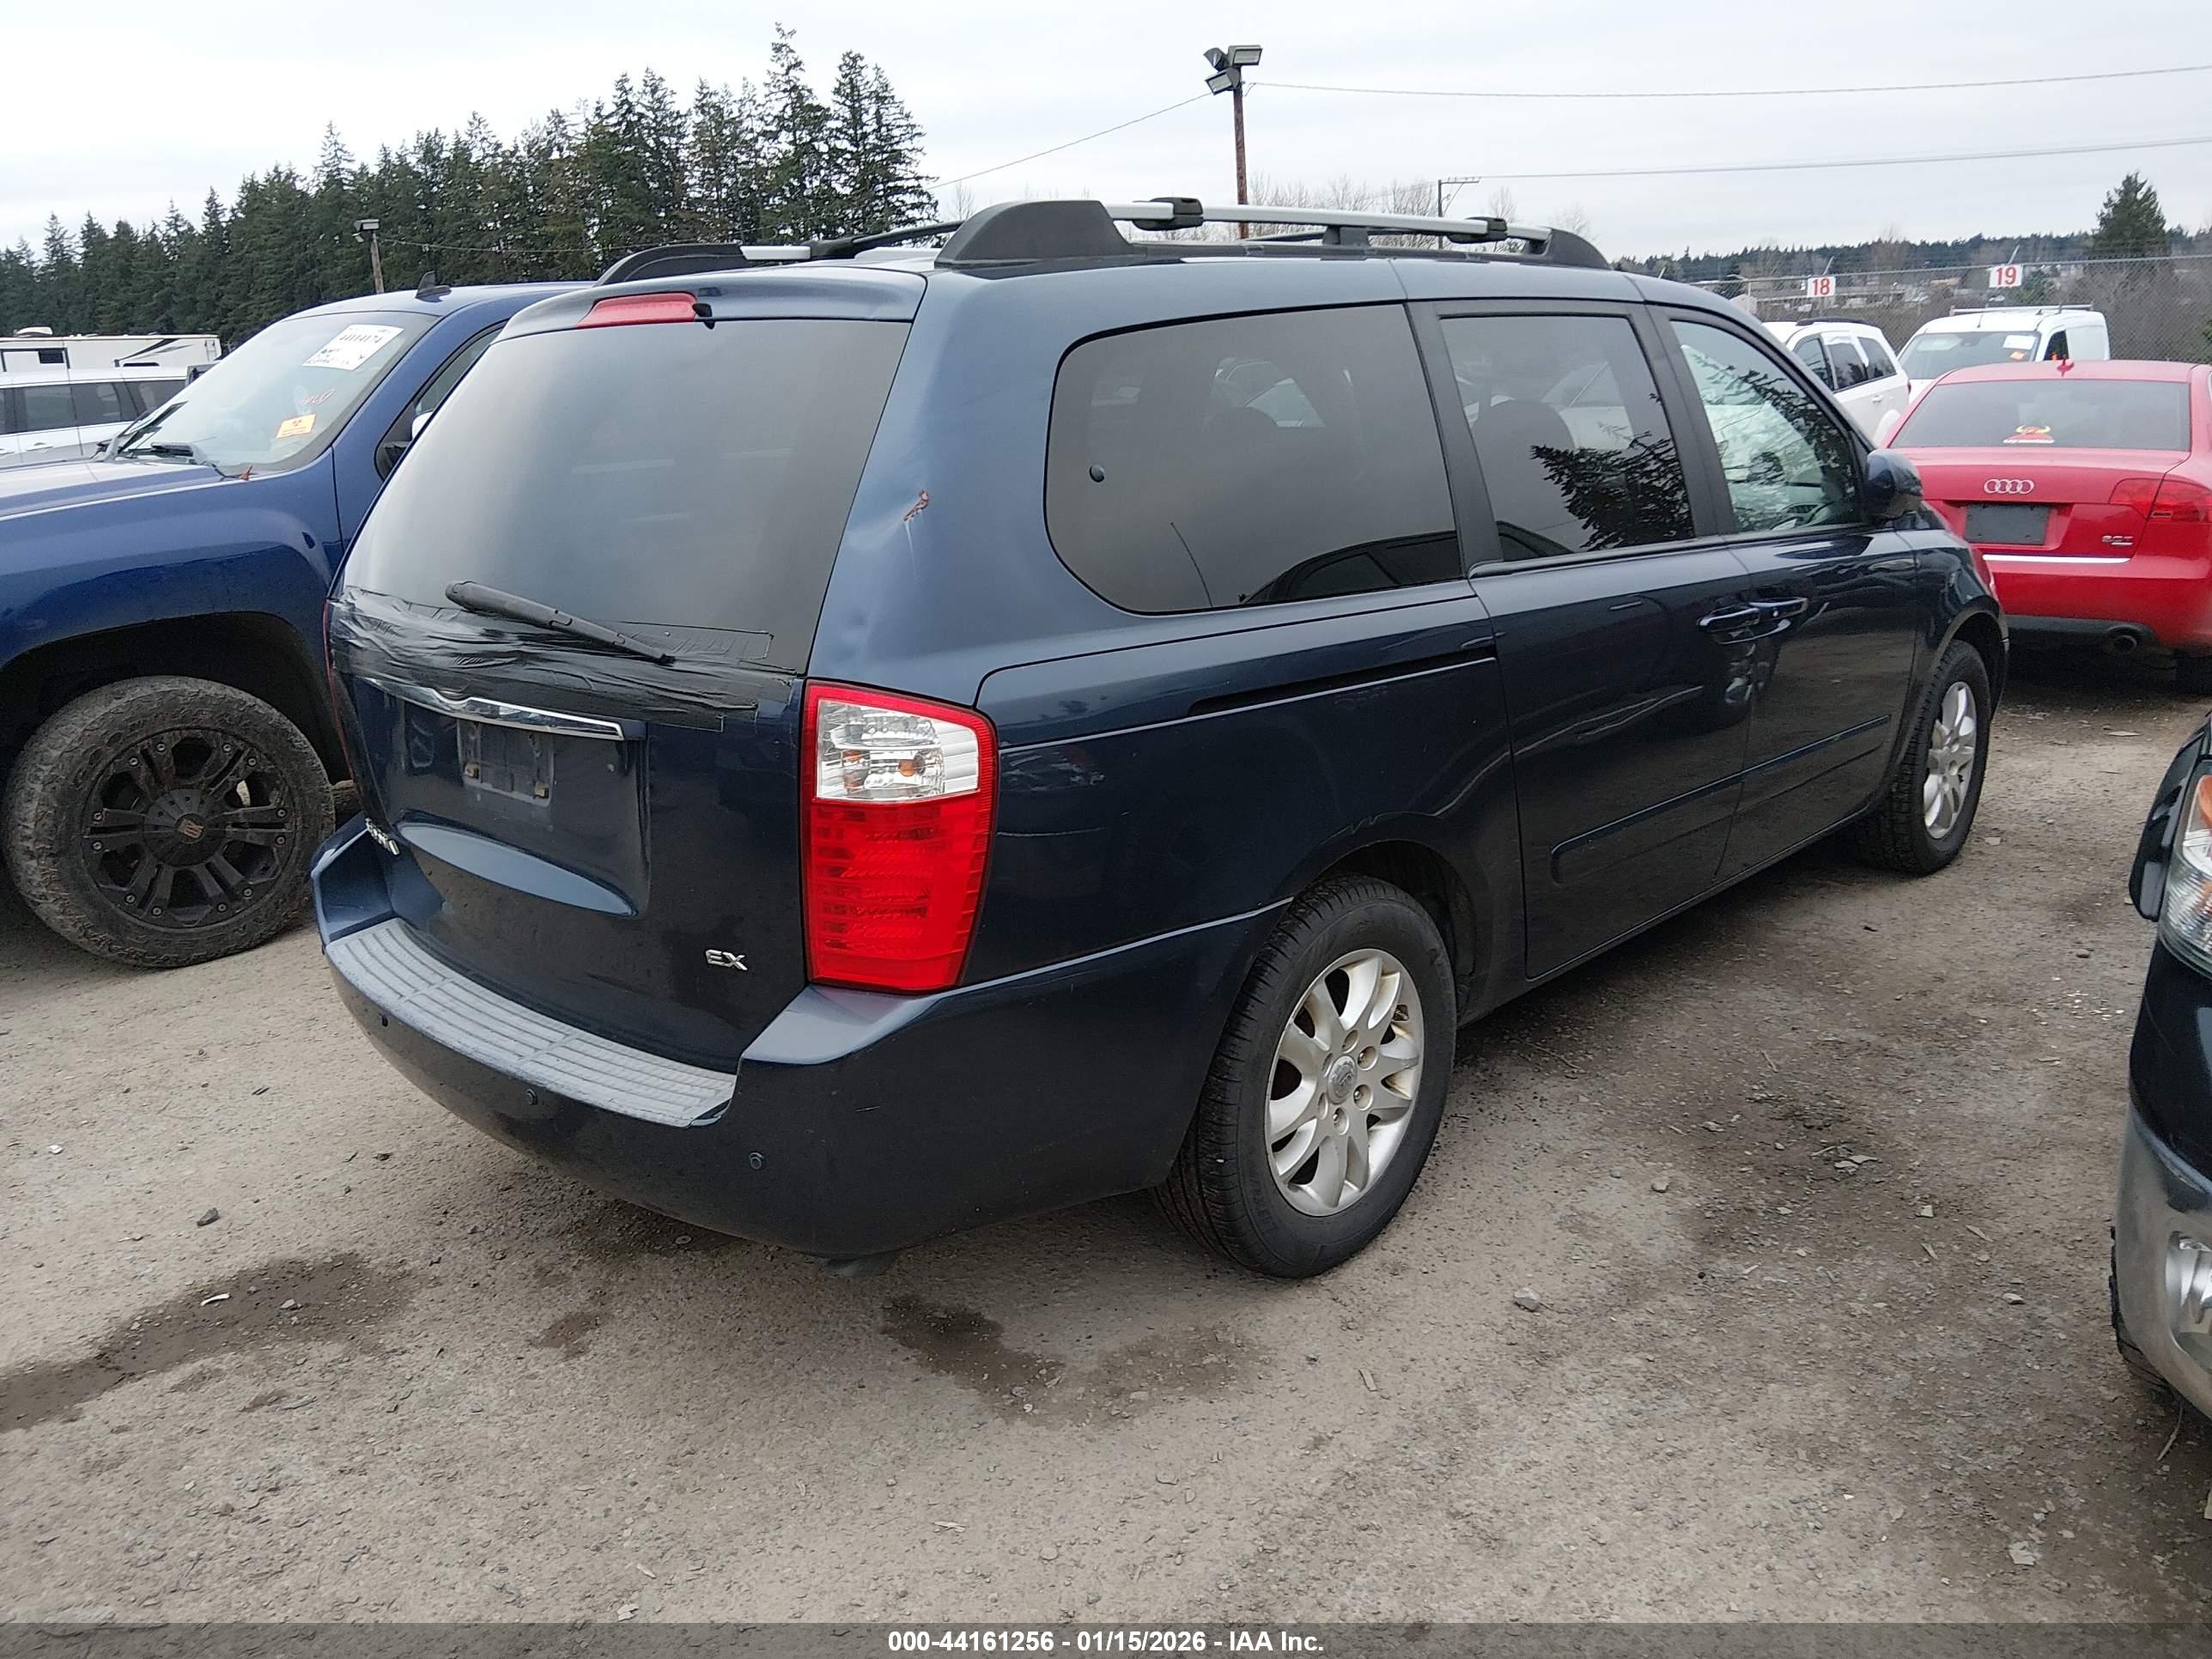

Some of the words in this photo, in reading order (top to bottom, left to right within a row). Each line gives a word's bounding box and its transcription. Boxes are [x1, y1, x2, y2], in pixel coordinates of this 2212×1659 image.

[1996, 266, 2017, 286] 19
[1813, 277, 1831, 296] 18
[705, 949, 748, 970] EX
